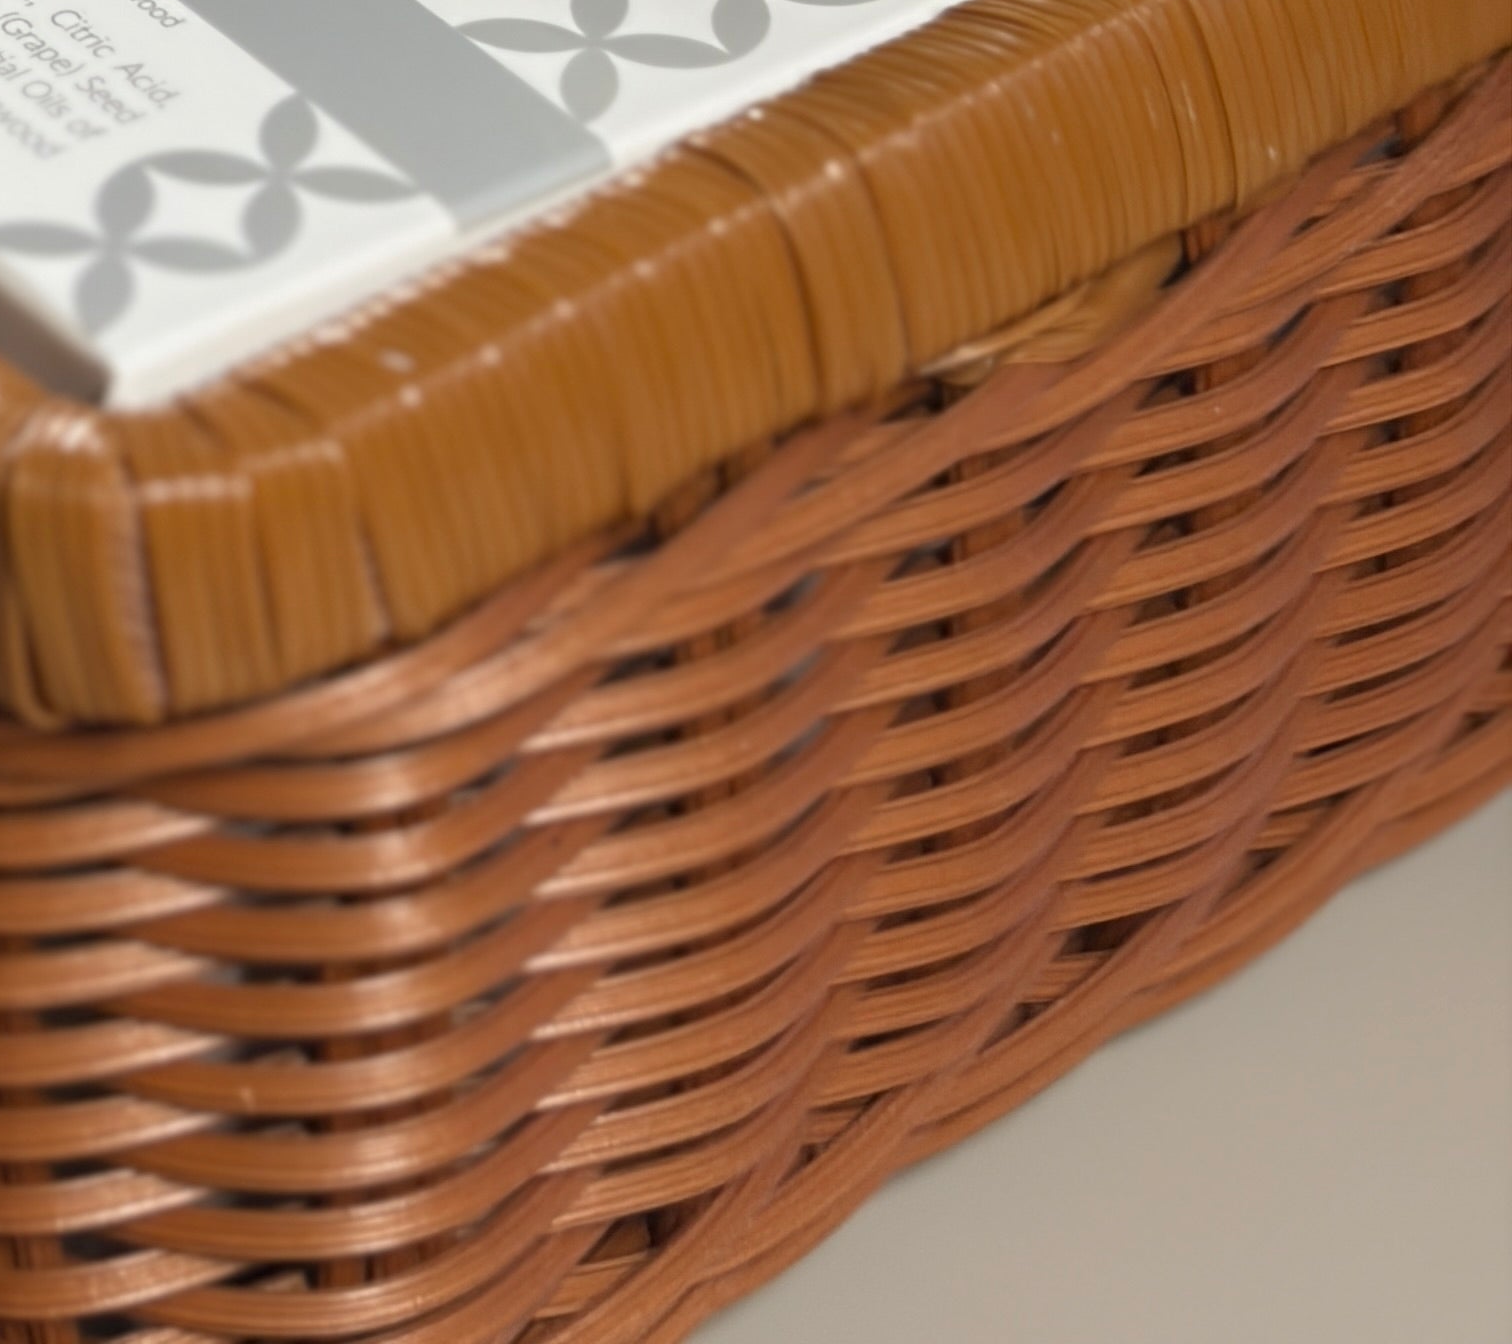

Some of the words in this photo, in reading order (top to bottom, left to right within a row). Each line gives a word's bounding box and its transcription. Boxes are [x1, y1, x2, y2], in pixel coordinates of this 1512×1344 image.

[50, 8, 118, 60] Citric
[20, 78, 73, 120] Oils
[74, 74, 148, 126] Seed
